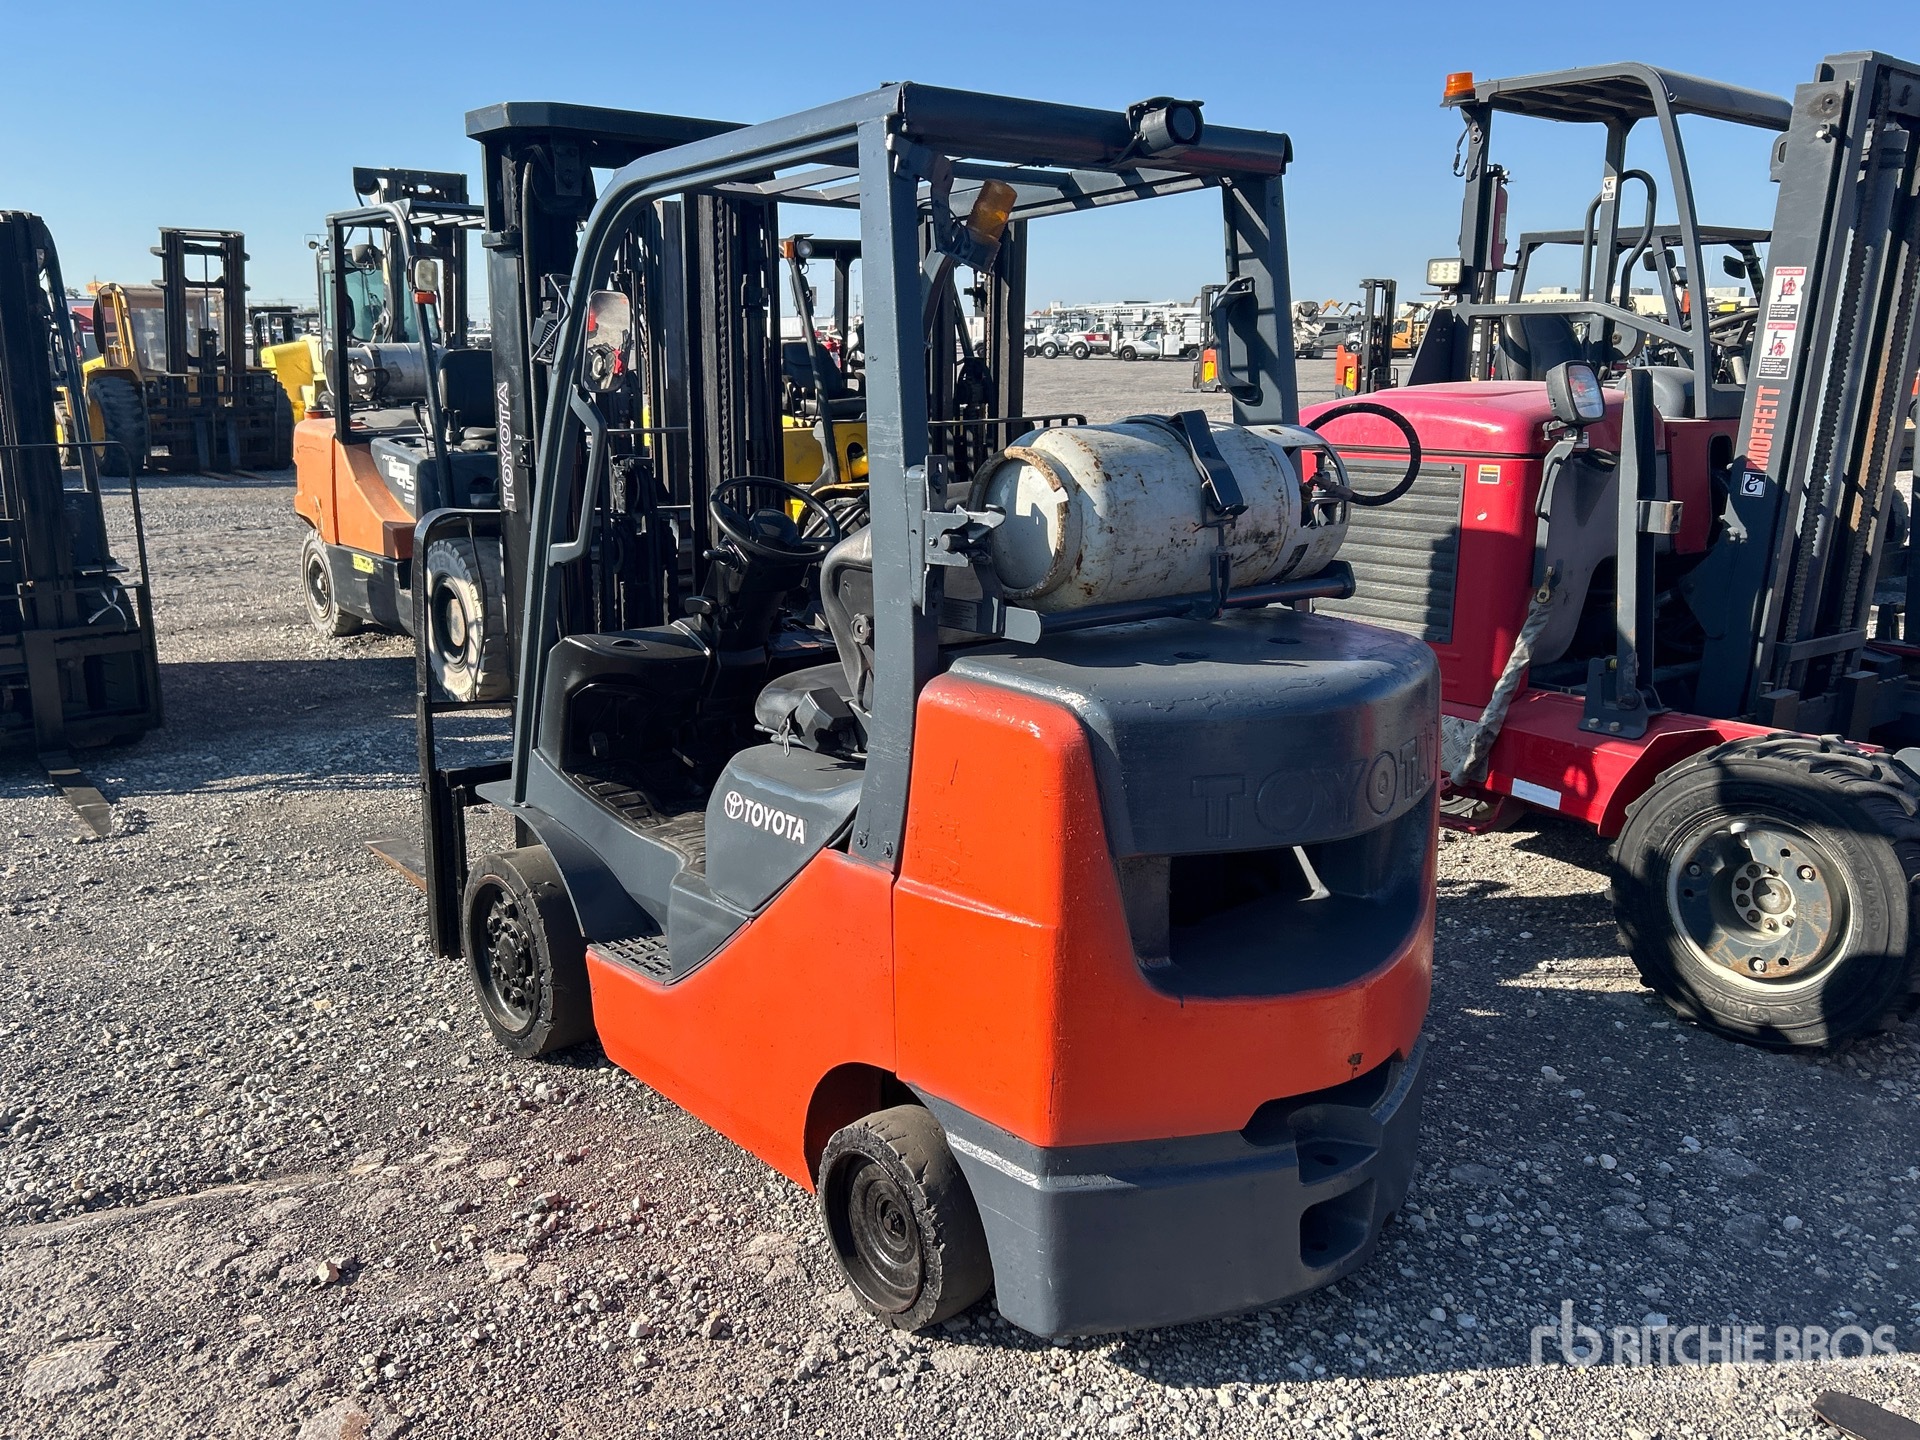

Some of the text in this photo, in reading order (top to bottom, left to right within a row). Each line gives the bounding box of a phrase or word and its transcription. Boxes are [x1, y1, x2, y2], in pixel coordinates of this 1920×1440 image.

[497, 381, 515, 507] TOYOTA
[1746, 385, 1781, 471] MOFFETT
[744, 798, 805, 845] TOYOTA
